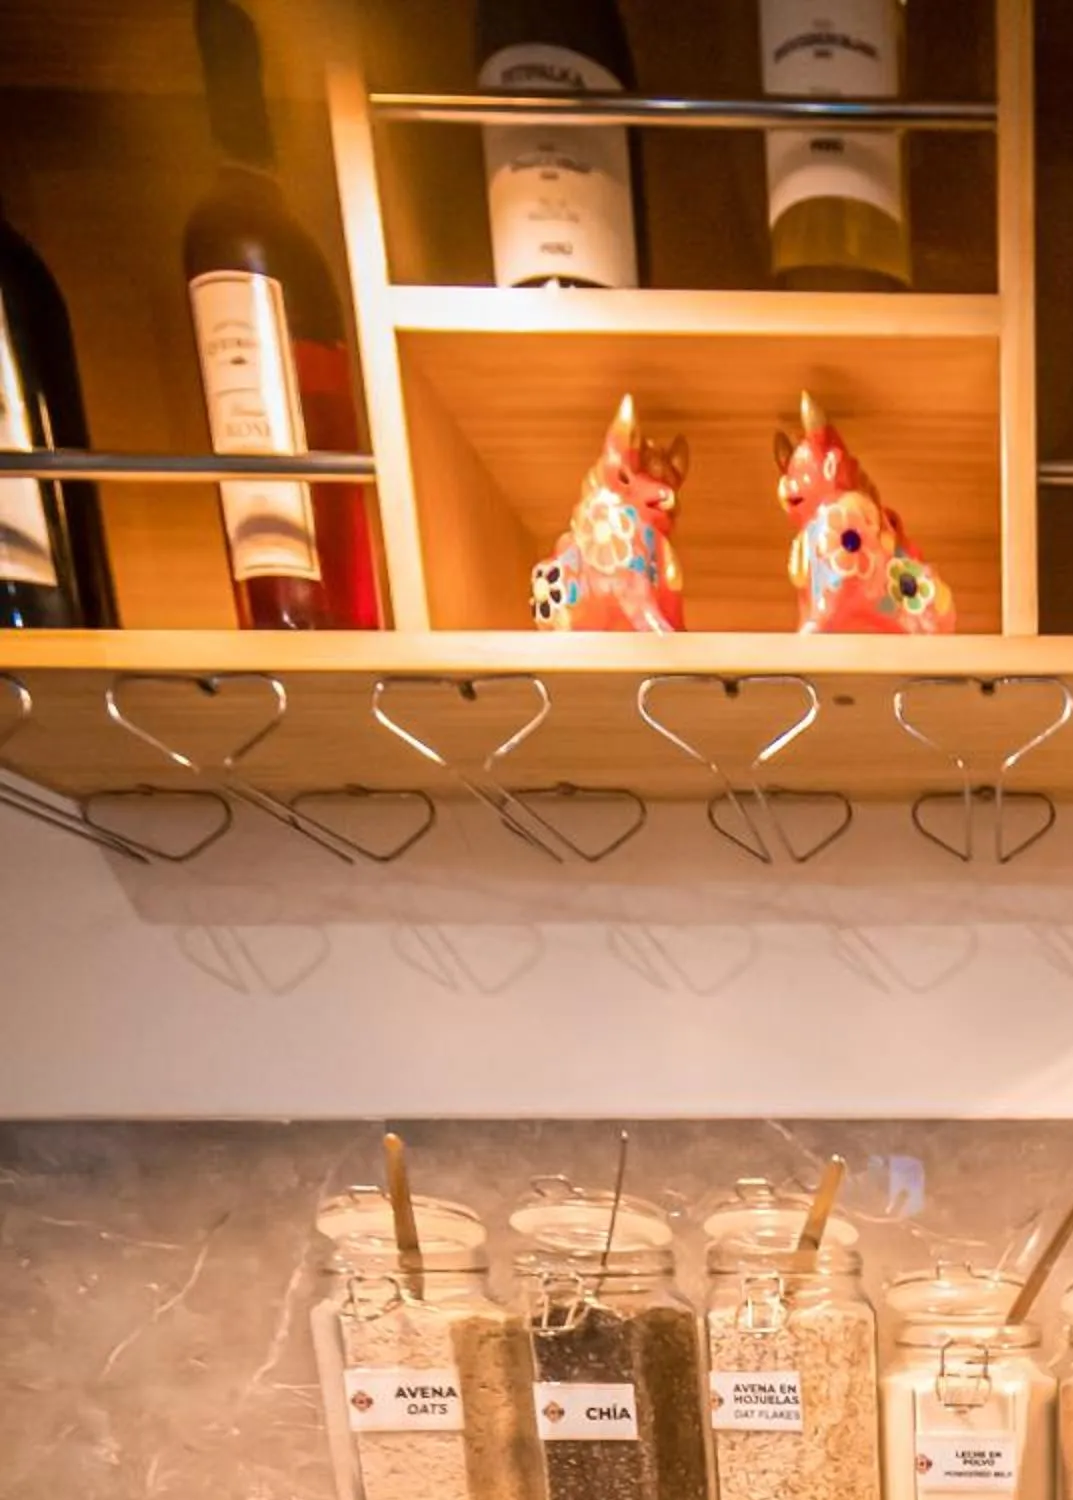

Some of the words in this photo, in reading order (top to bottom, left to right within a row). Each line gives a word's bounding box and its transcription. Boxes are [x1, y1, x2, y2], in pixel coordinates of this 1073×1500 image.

[394, 1385, 458, 1399] AVENA
[733, 1383, 776, 1393] AVENA
[779, 1384, 797, 1394] EN
[733, 1395, 800, 1405] HOJUELAS
[406, 1403, 449, 1415] OATS
[585, 1404, 632, 1421] CHÍA
[734, 1409, 755, 1419] OAT
[757, 1409, 801, 1420] FLAKES
